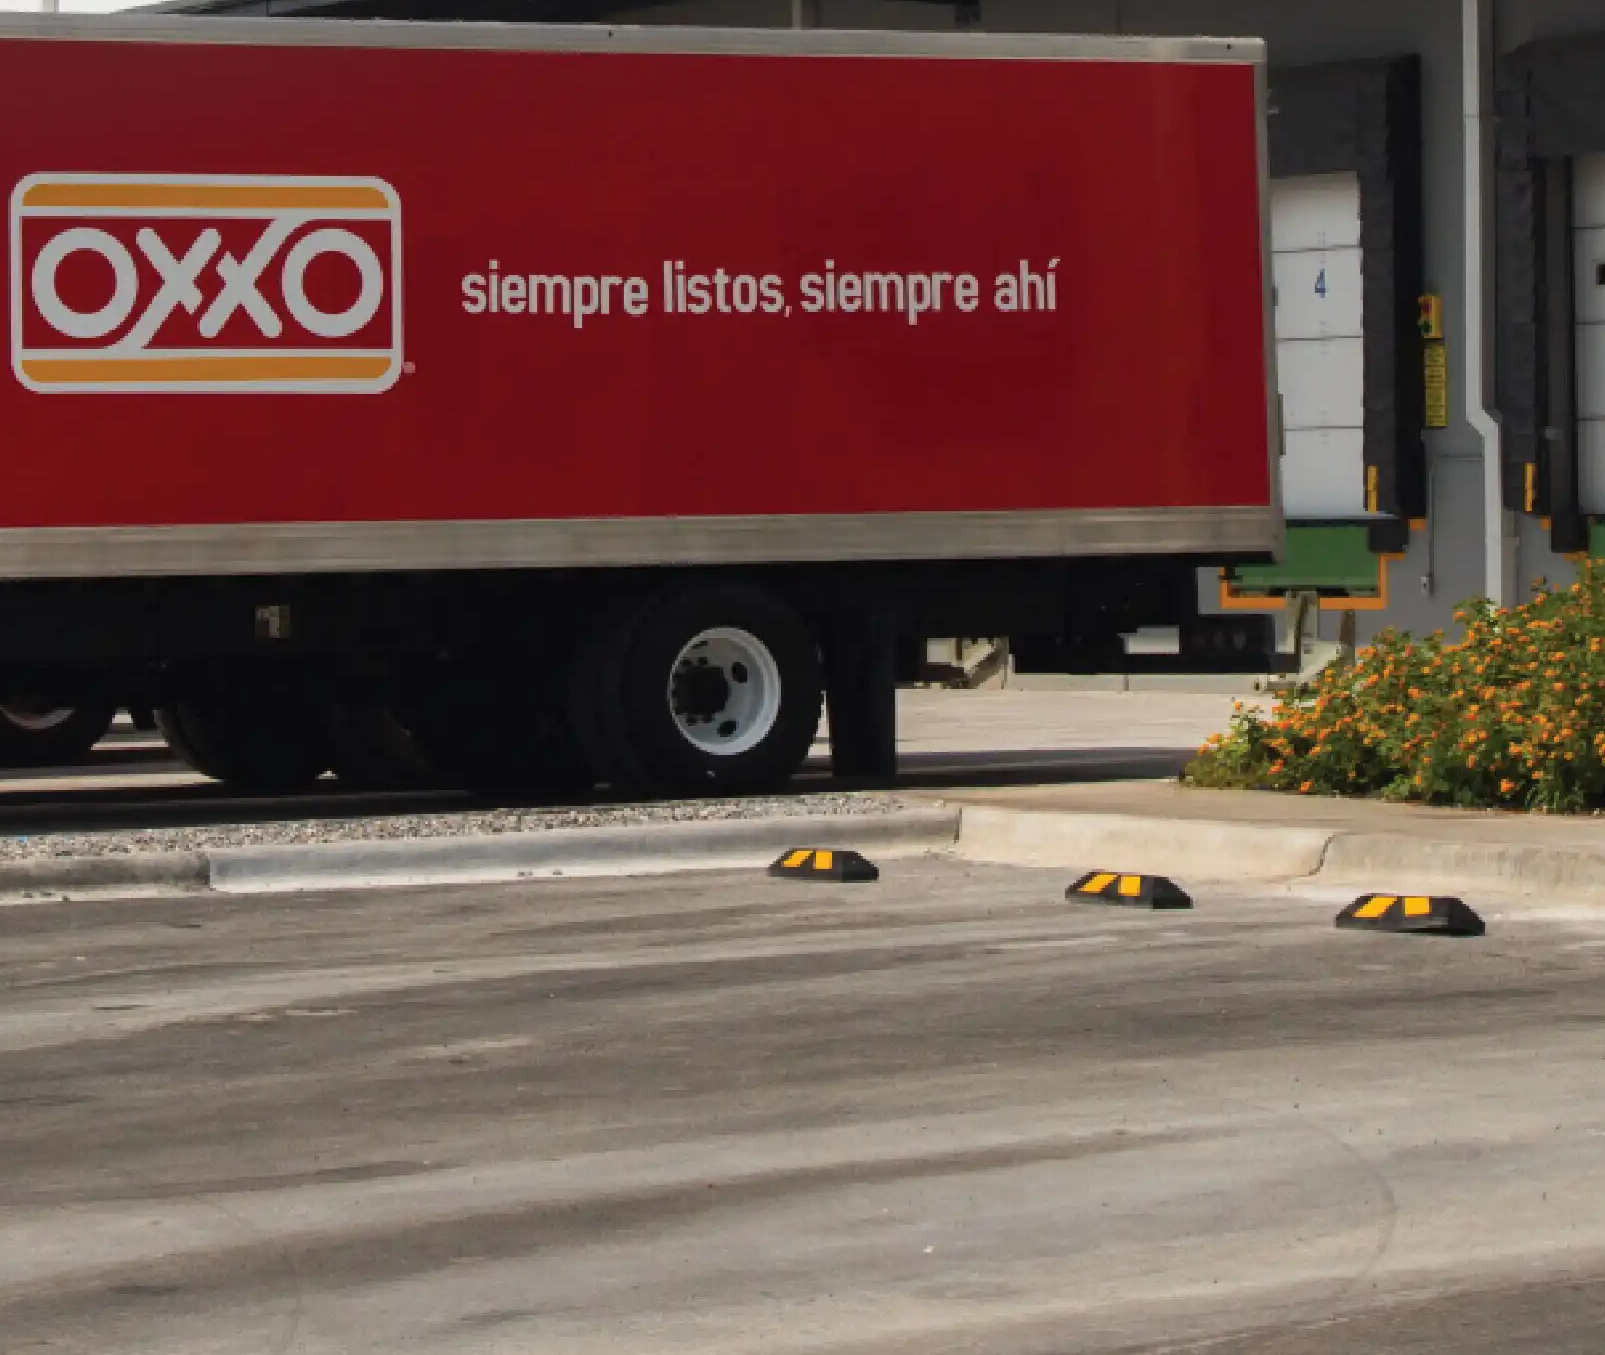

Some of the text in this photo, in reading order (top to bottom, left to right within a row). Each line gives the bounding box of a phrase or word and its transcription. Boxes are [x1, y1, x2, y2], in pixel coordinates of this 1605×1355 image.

[31, 222, 384, 344] OXXO
[461, 258, 1061, 329] siempre listos, siempre ahí
[1314, 268, 1328, 299] 4
